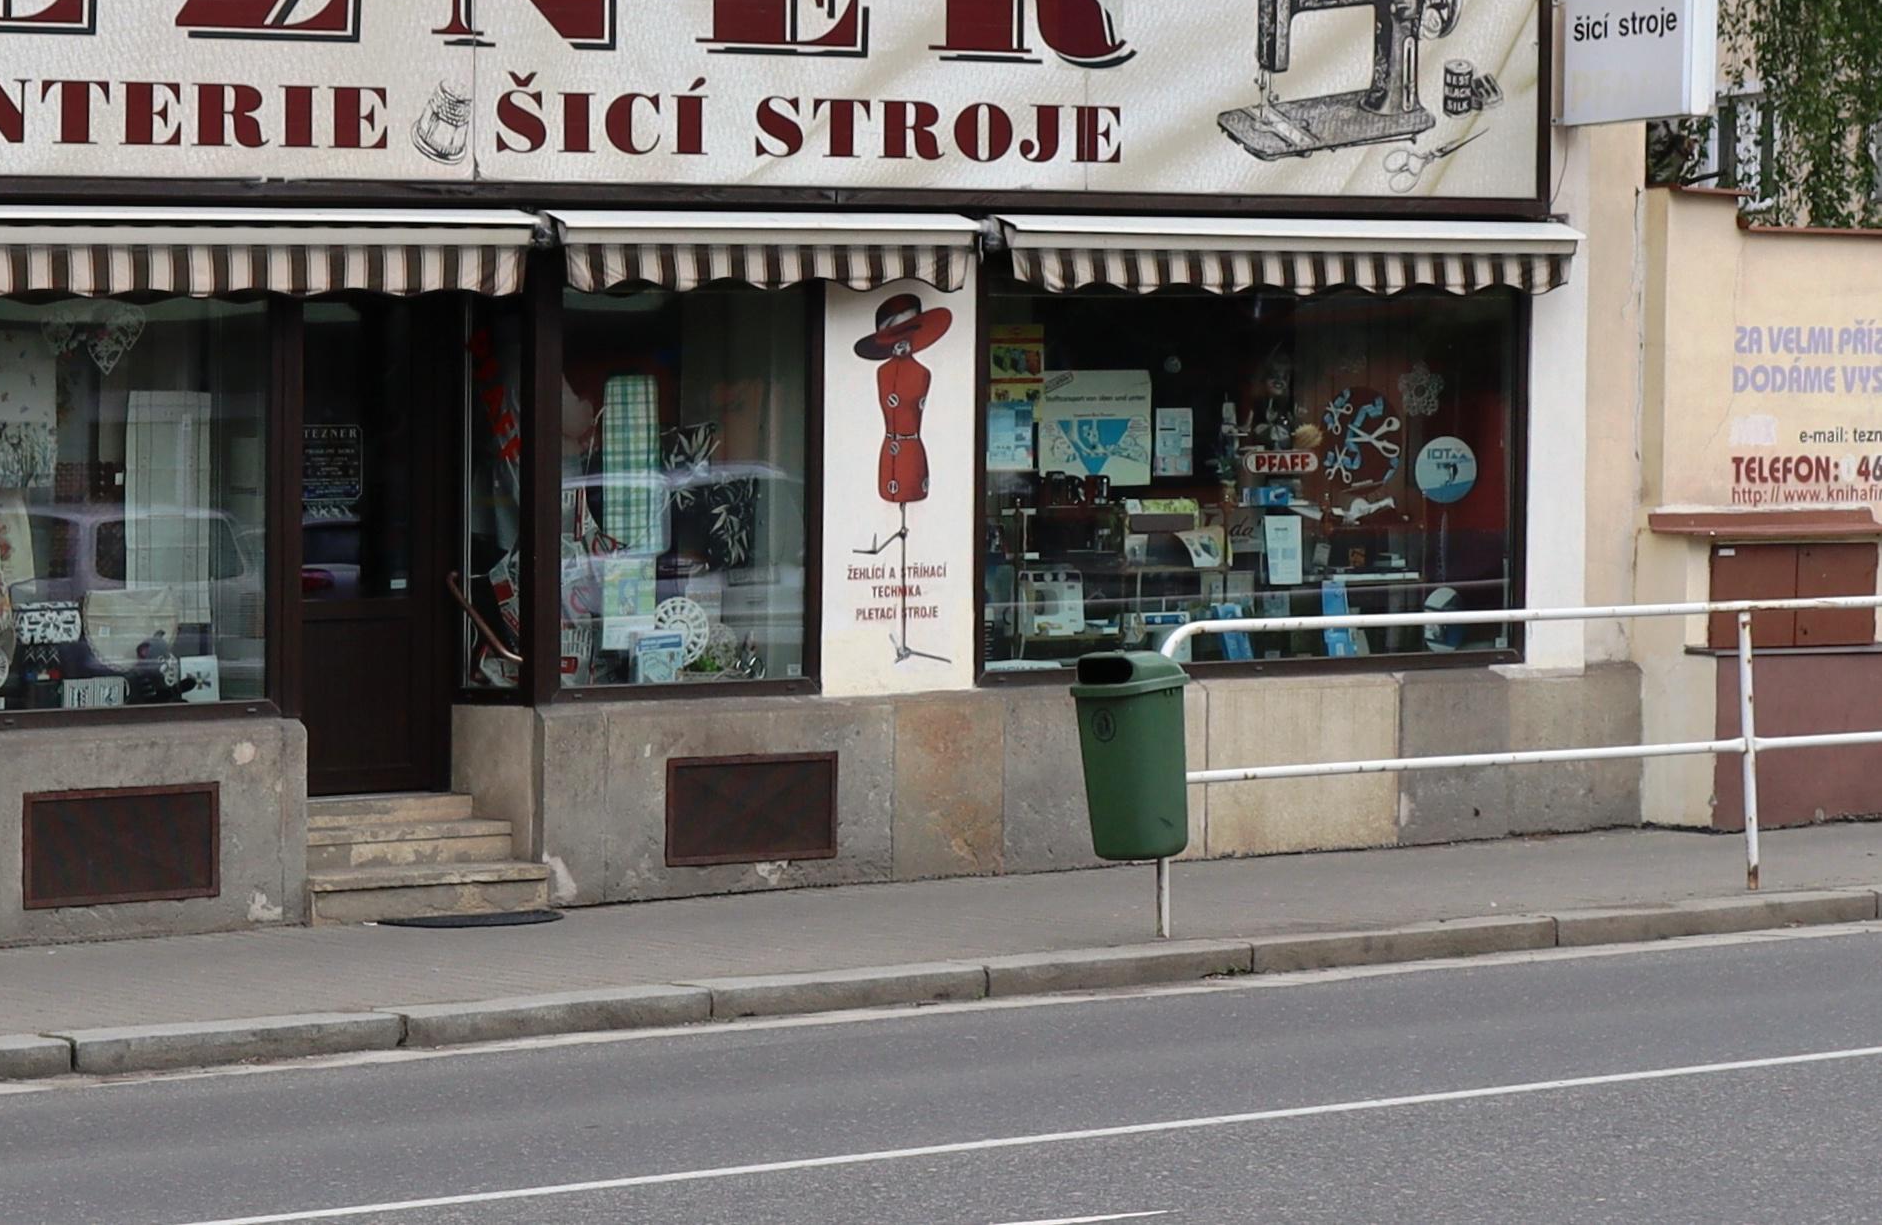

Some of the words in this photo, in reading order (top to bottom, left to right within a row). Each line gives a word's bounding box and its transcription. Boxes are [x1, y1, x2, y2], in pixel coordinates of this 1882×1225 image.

[1574, 13, 1609, 42] šicí
[1618, 7, 1678, 38] stroje
[1445, 73, 1470, 85] BEST
[1446, 99, 1469, 112] SILK
[495, 71, 709, 158] ŠICÍ
[755, 94, 1122, 164] STROJE
[1734, 326, 1763, 354] ZA
[1768, 326, 1833, 354] VELMI
[1733, 357, 1836, 393] DODÁME
[1799, 426, 1848, 443] e-mail:
[1254, 454, 1311, 472] PFAFF
[1731, 455, 1840, 484] TELEFON:
[847, 563, 886, 581] ŽEHLÍCÍ
[889, 566, 896, 579] A
[856, 604, 898, 621] PLETACÍ
